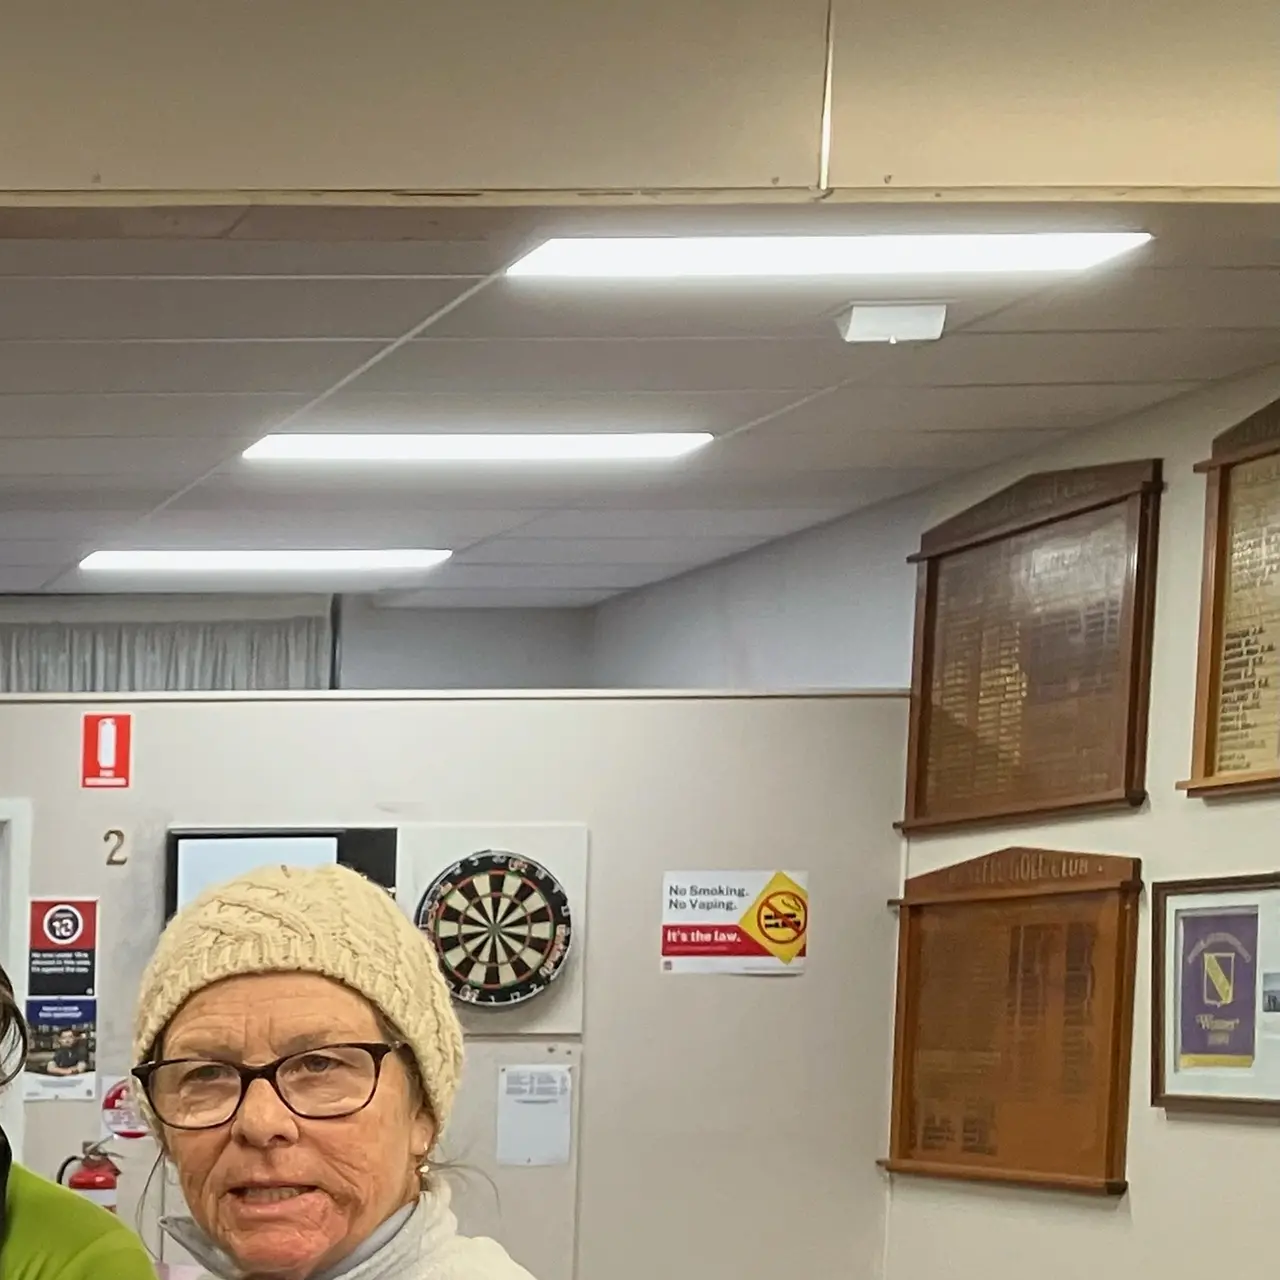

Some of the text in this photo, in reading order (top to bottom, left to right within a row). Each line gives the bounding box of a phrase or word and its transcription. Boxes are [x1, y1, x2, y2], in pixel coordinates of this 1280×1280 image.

[103, 829, 128, 867] 2
[669, 885, 749, 898] No Smoking.
[669, 898, 739, 912] No Vaping.
[667, 928, 743, 943] It's the law.
